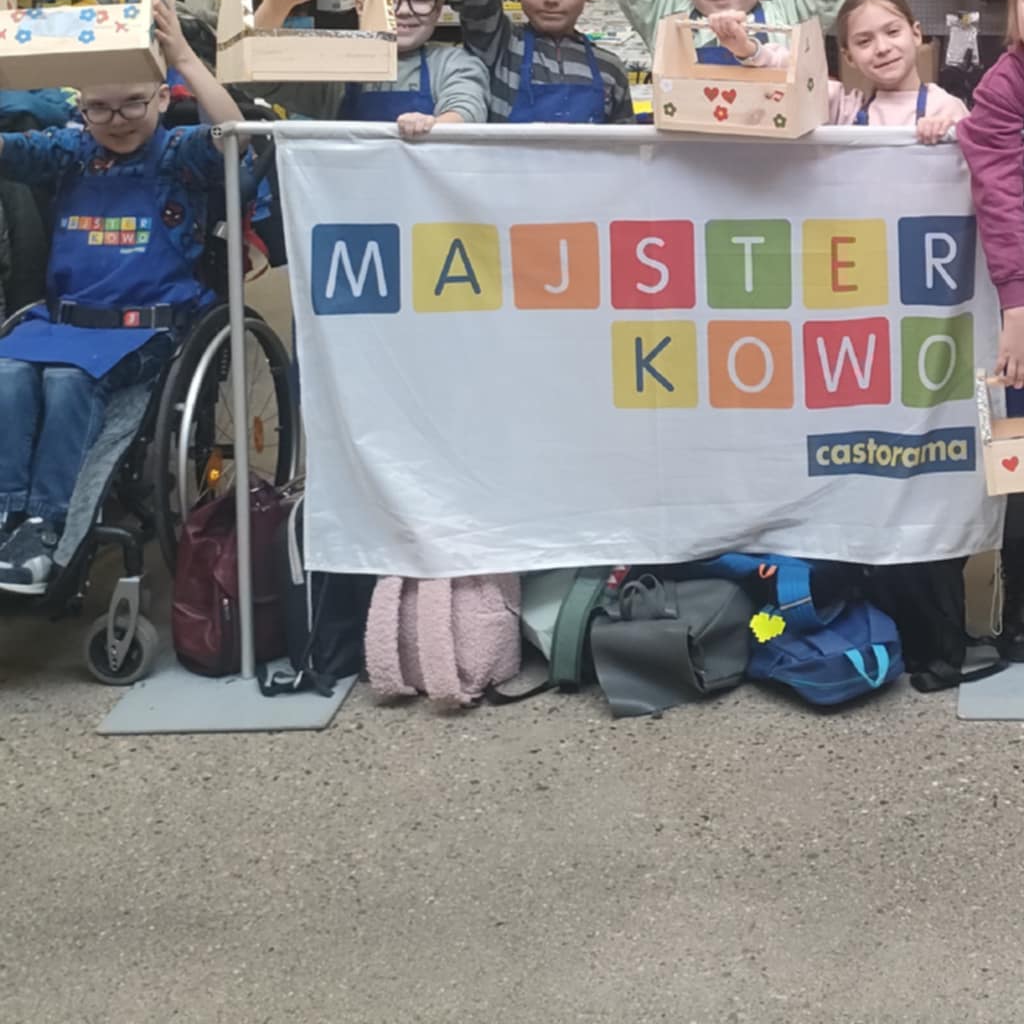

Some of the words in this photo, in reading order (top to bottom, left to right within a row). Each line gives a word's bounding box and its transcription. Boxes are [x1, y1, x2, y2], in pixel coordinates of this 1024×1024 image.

[325, 232, 958, 300] MAJSTER
[634, 334, 958, 393] KOWO
[815, 437, 969, 469] castorama
